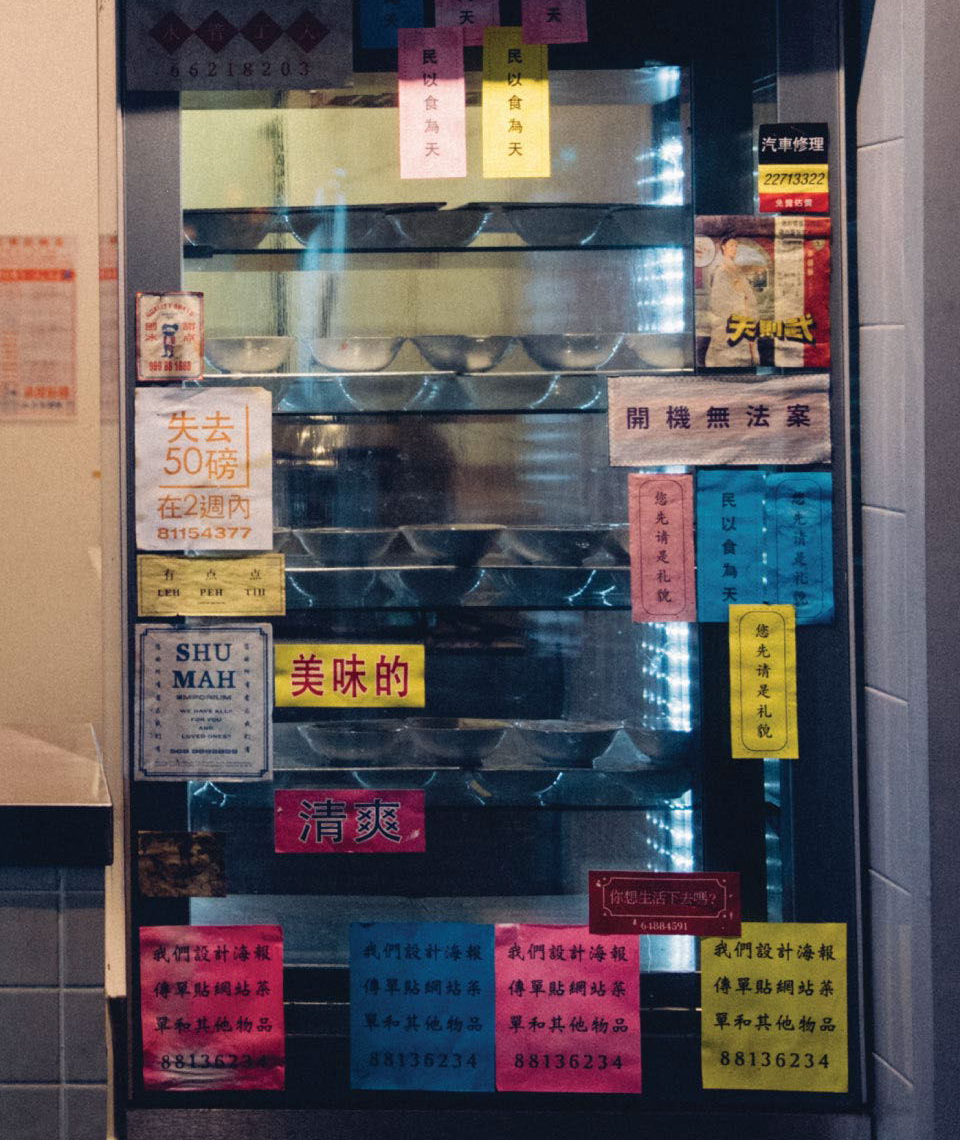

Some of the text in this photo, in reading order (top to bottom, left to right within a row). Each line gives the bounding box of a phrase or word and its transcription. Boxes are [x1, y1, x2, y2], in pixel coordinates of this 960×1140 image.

[171, 62, 310, 78] 66218203
[422, 49, 440, 158] 民以食為天
[507, 49, 523, 157] 民以食為天
[761, 136, 825, 153] 汽車修理
[763, 172, 826, 186] 22713322
[626, 403, 812, 430] 開機無法案
[167, 411, 235, 444] 失去
[163, 447, 239, 481] 50磅
[157, 527, 252, 540] 81154377
[720, 492, 738, 603] 民以食為天
[176, 643, 232, 662] SHU
[172, 670, 236, 688] MAH
[290, 653, 409, 698] 美味的
[299, 798, 402, 844] 清爽
[507, 943, 629, 962] 我們設計海報
[714, 940, 837, 962] 我們設計海報
[508, 1014, 629, 1034] 單和其他物品
[714, 1012, 837, 1034] 單和其他物品
[369, 1051, 477, 1069] 88136234
[514, 1053, 623, 1069] 88136234
[720, 1051, 830, 1068] 88136234
